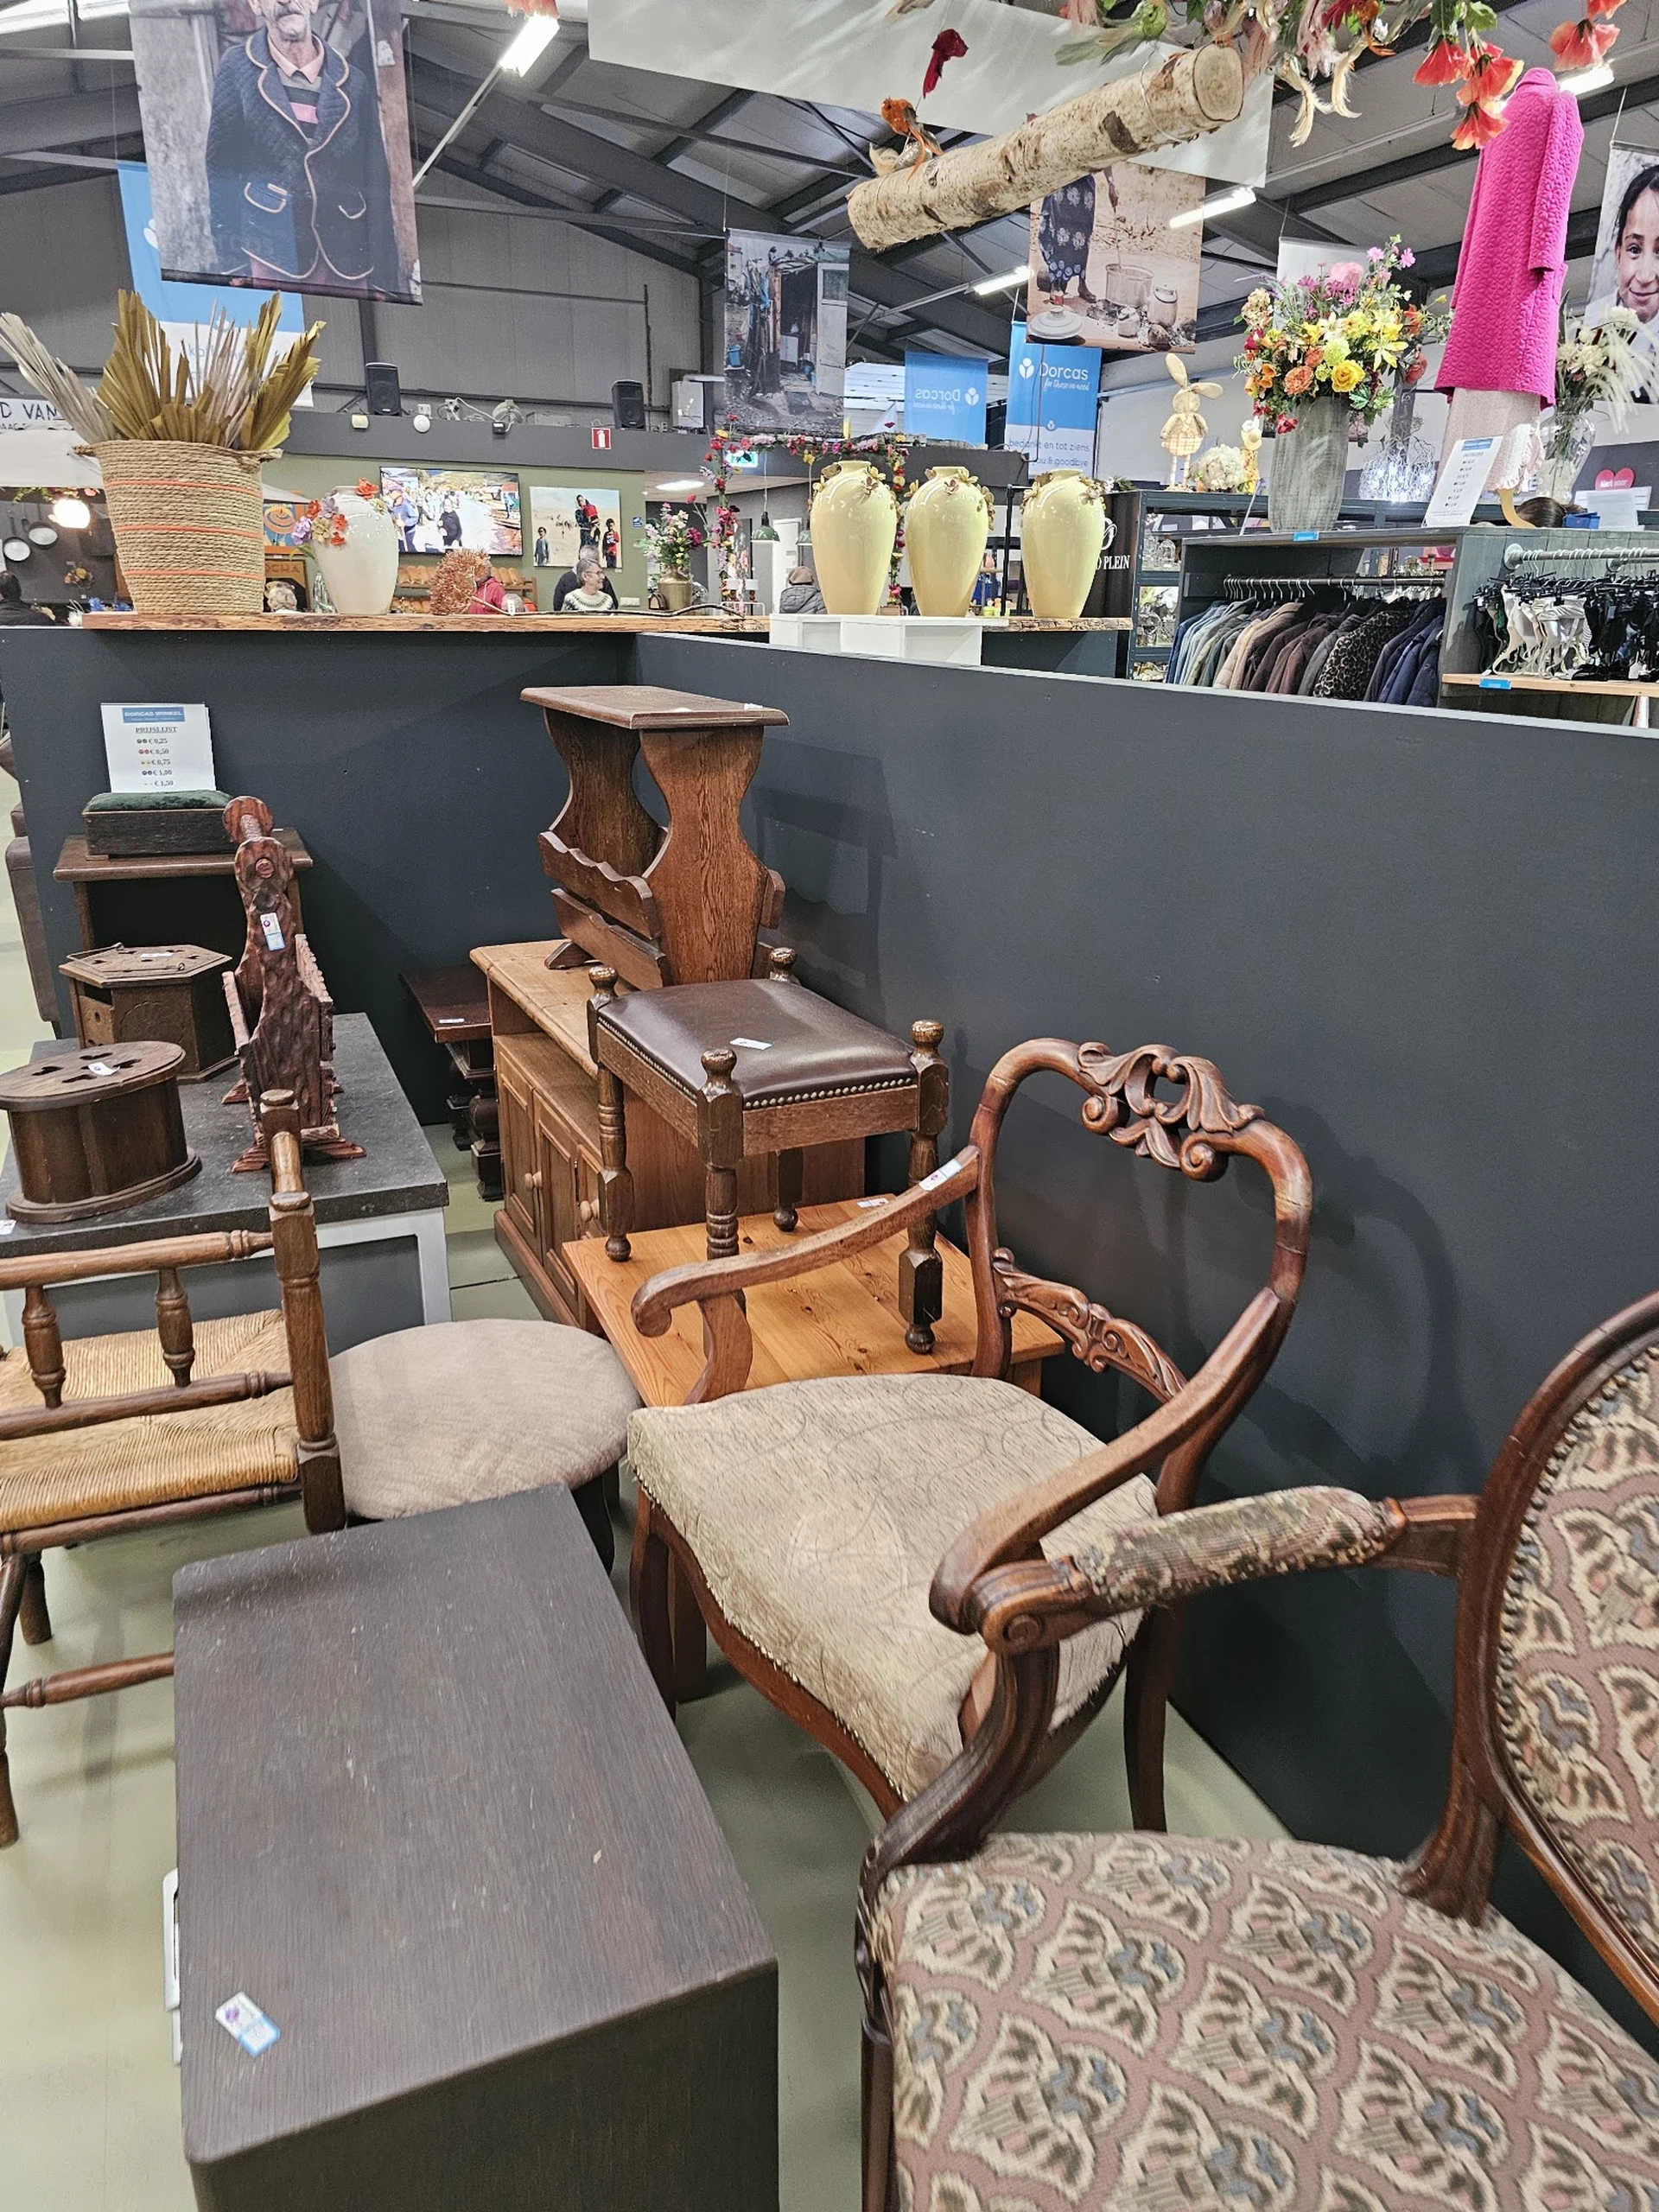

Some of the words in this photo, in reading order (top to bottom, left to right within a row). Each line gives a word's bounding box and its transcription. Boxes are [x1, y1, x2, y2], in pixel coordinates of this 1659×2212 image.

[1039, 362, 1089, 380] Dorcas
[1056, 442, 1068, 450] tot
[1070, 443, 1090, 452] ziens
[1054, 457, 1089, 467] goodbye
[1103, 555, 1130, 569] PLEIN
